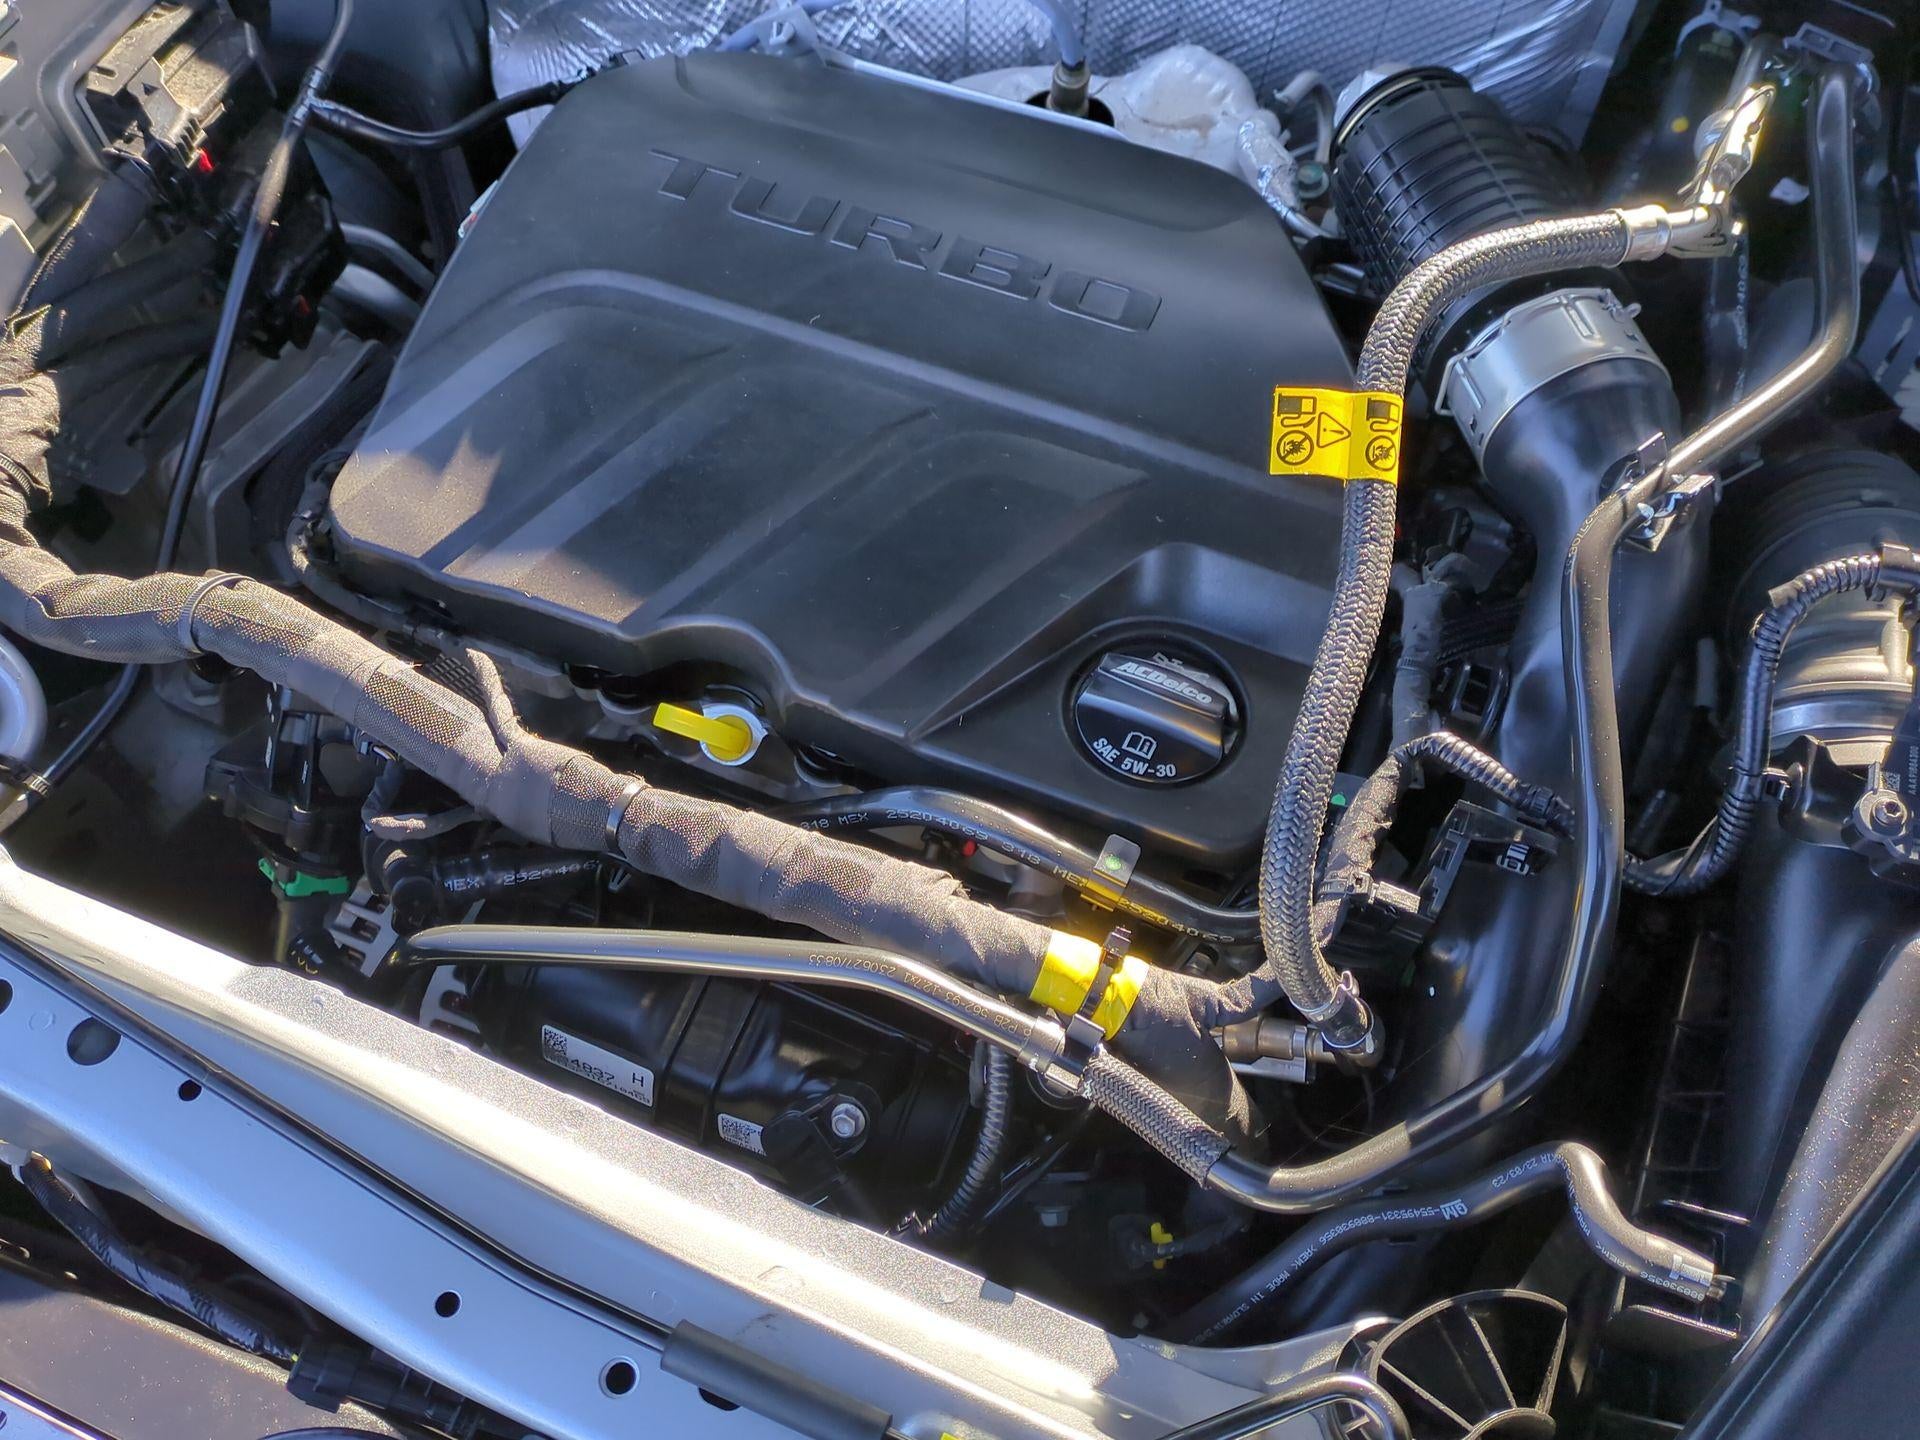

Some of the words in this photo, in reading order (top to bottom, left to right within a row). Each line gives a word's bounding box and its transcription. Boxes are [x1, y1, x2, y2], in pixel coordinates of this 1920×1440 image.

[648, 148, 1164, 333] TURBO
[1114, 661, 1213, 704] ACDelco
[1092, 737, 1121, 763] SAE
[1120, 758, 1177, 778] 5W-30
[837, 812, 869, 826] MEX
[631, 1072, 645, 1088] H
[1439, 1198, 1468, 1221] GM
[1265, 1269, 1291, 1292] MADE
